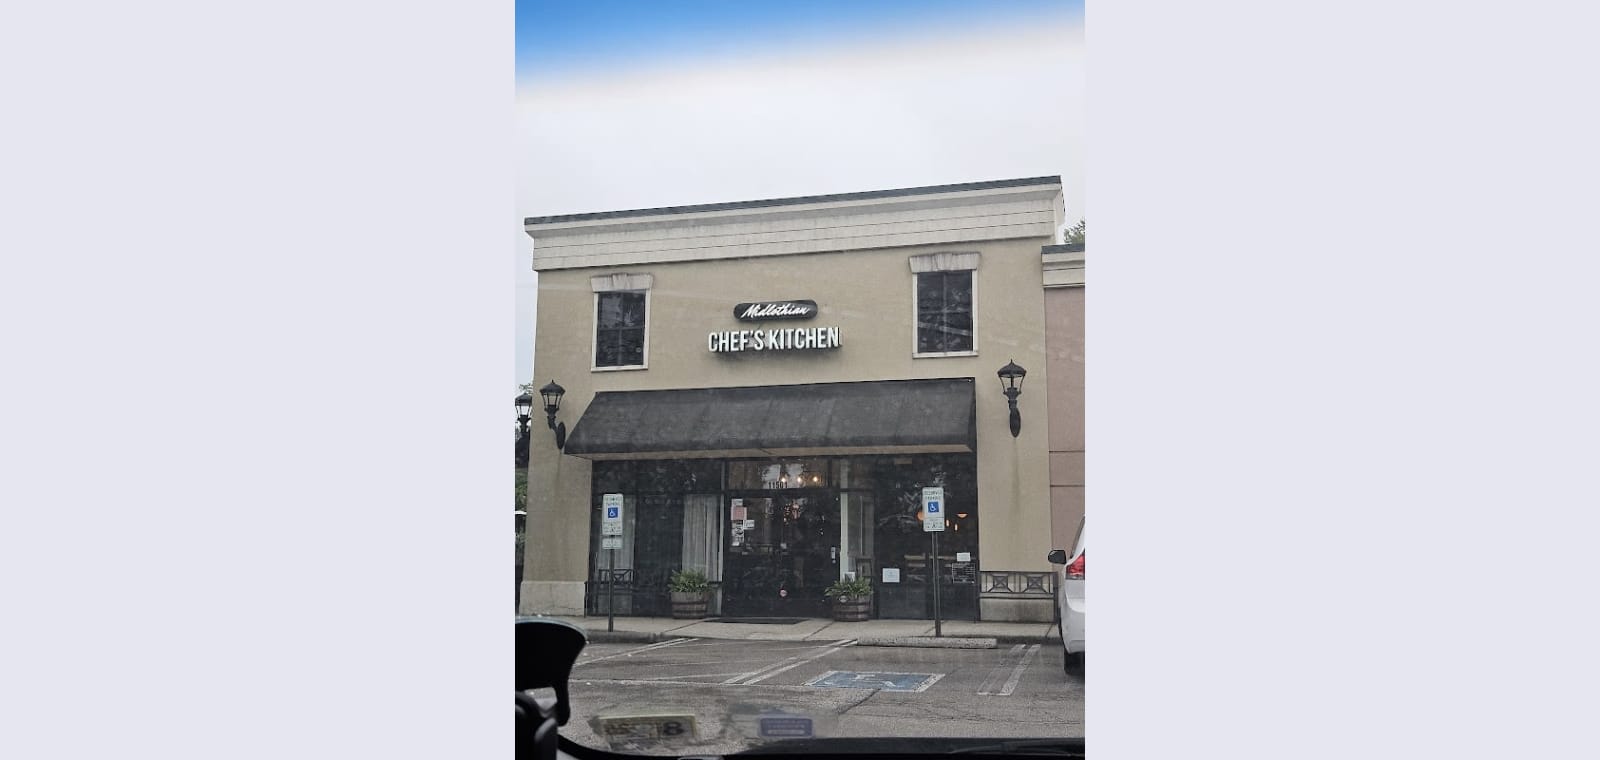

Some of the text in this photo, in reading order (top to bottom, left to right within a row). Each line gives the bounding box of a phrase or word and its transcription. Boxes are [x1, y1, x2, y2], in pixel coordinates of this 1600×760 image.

[741, 303, 811, 319] Midlothian
[708, 326, 840, 353] CHEF'S KITCHEN
